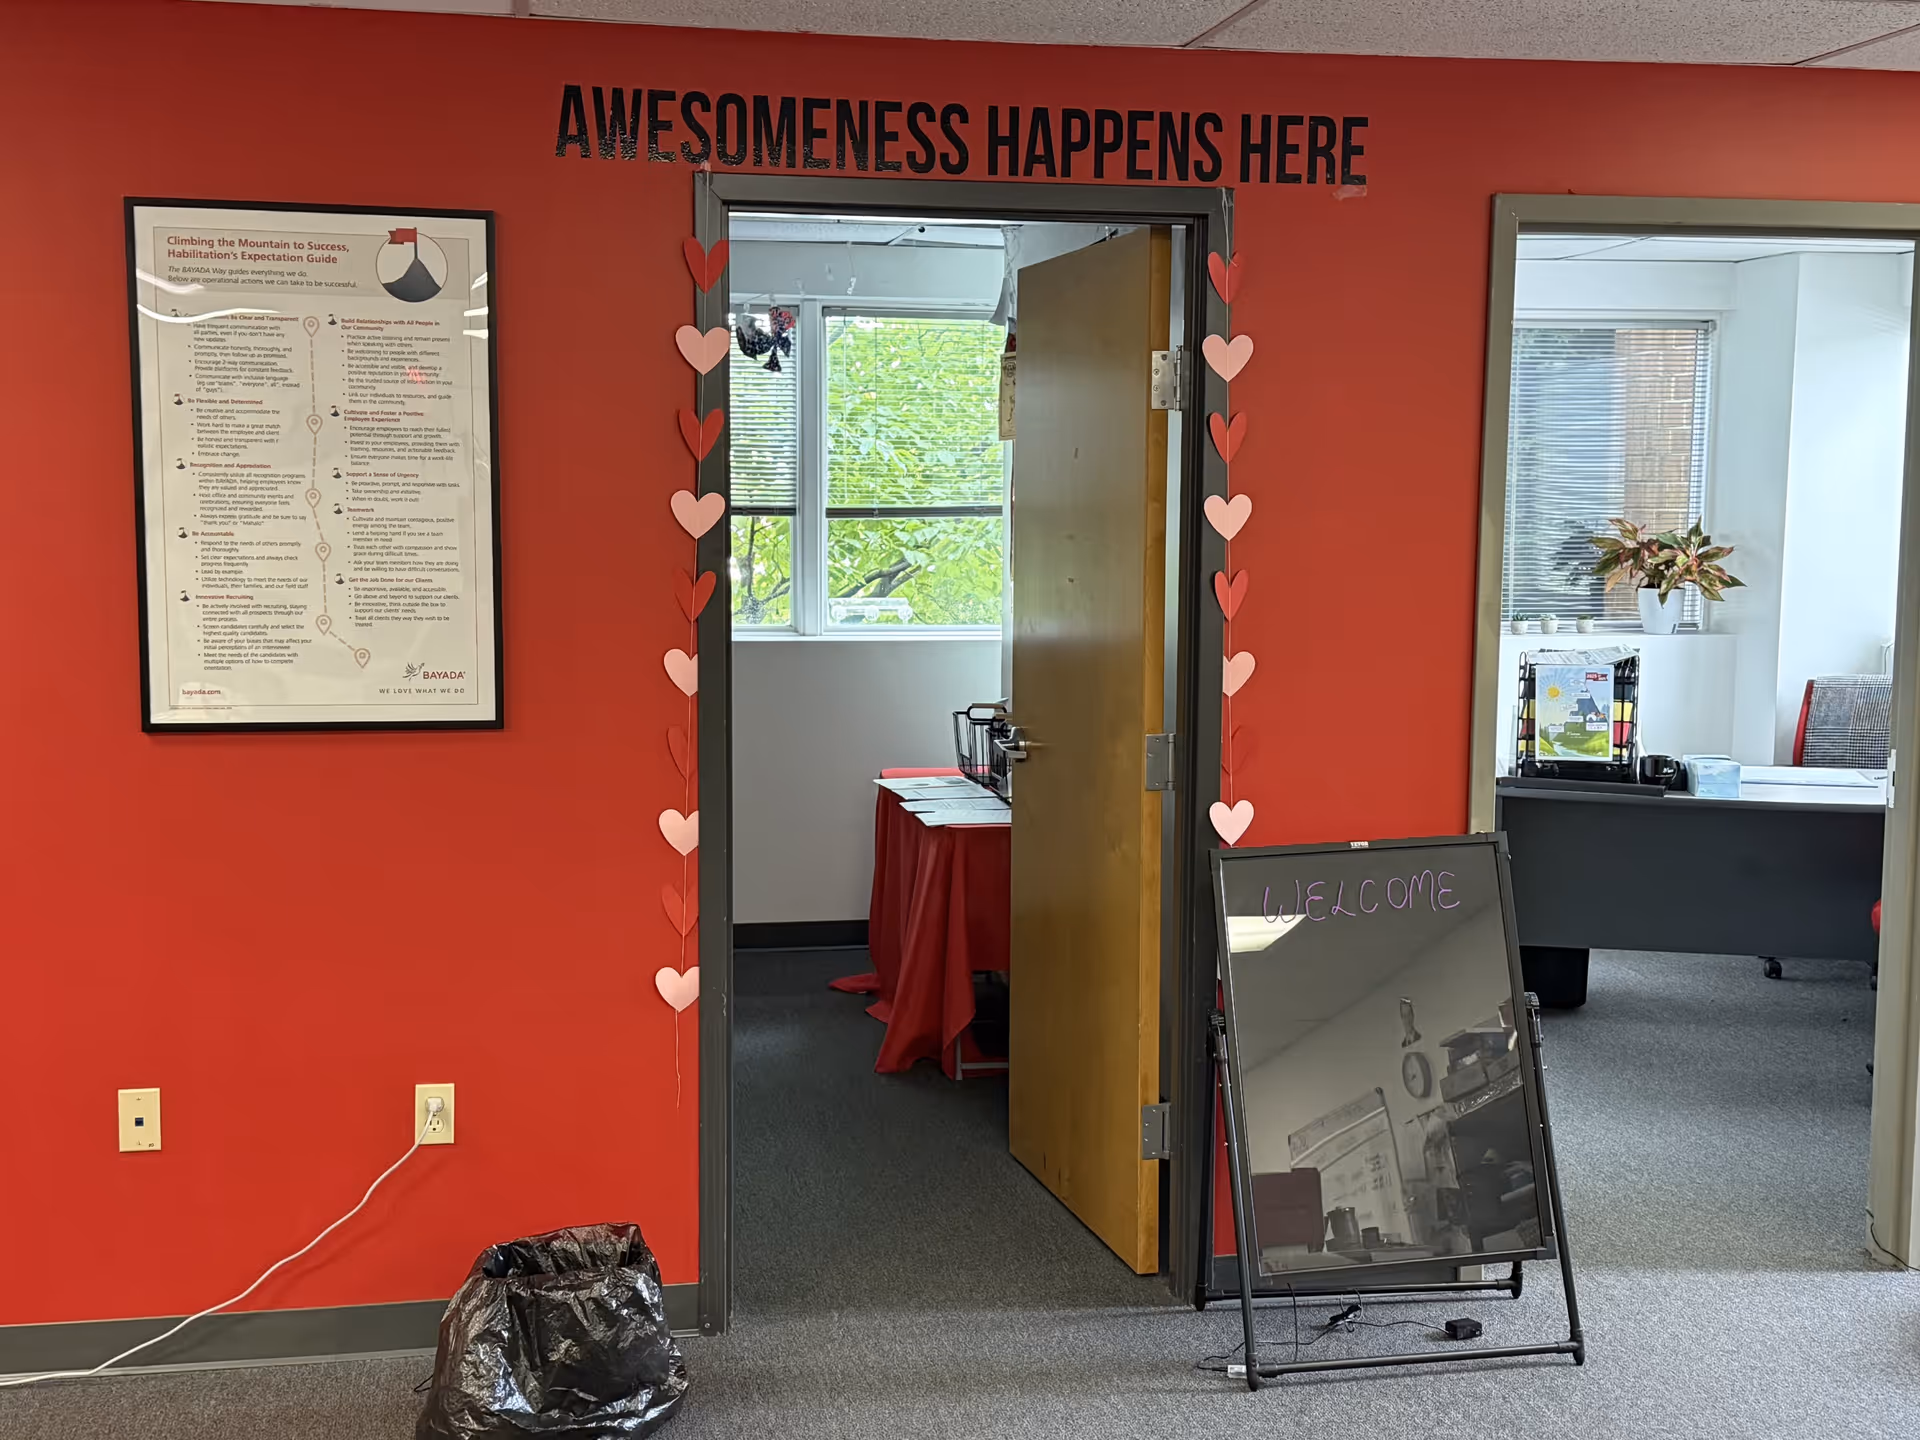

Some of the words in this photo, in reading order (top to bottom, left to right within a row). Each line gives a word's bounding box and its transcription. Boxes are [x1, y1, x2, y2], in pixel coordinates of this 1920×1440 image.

[554, 84, 970, 177] AWESOMENESS
[987, 105, 1225, 183] HAPPENS
[1239, 113, 1370, 186] HERE
[167, 236, 214, 249] Climbing
[216, 237, 235, 247] the
[237, 238, 290, 249] Mountain
[292, 240, 304, 250] to
[306, 240, 350, 254] Success,
[168, 249, 238, 260] Habilitation's
[240, 251, 303, 265] Expectation
[305, 253, 338, 263] Guide
[168, 265, 180, 273] The
[181, 265, 210, 274] BAYADA
[211, 266, 226, 276] Way
[227, 266, 249, 277] guides
[250, 267, 284, 278] everything
[297, 269, 308, 277] do.
[168, 274, 188, 282] Below
[201, 275, 239, 286] operational
[240, 276, 263, 285] actions
[289, 278, 304, 286] take
[305, 278, 312, 287] to
[313, 279, 323, 287] be
[324, 279, 357, 288] successful.
[265, 315, 299, 323] Transparent
[355, 318, 392, 327] Relationships
[344, 415, 370, 423] Employee
[370, 416, 400, 424] Experience
[423, 671, 464, 679] BAYADA
[1263, 869, 1461, 924] WELCOME
